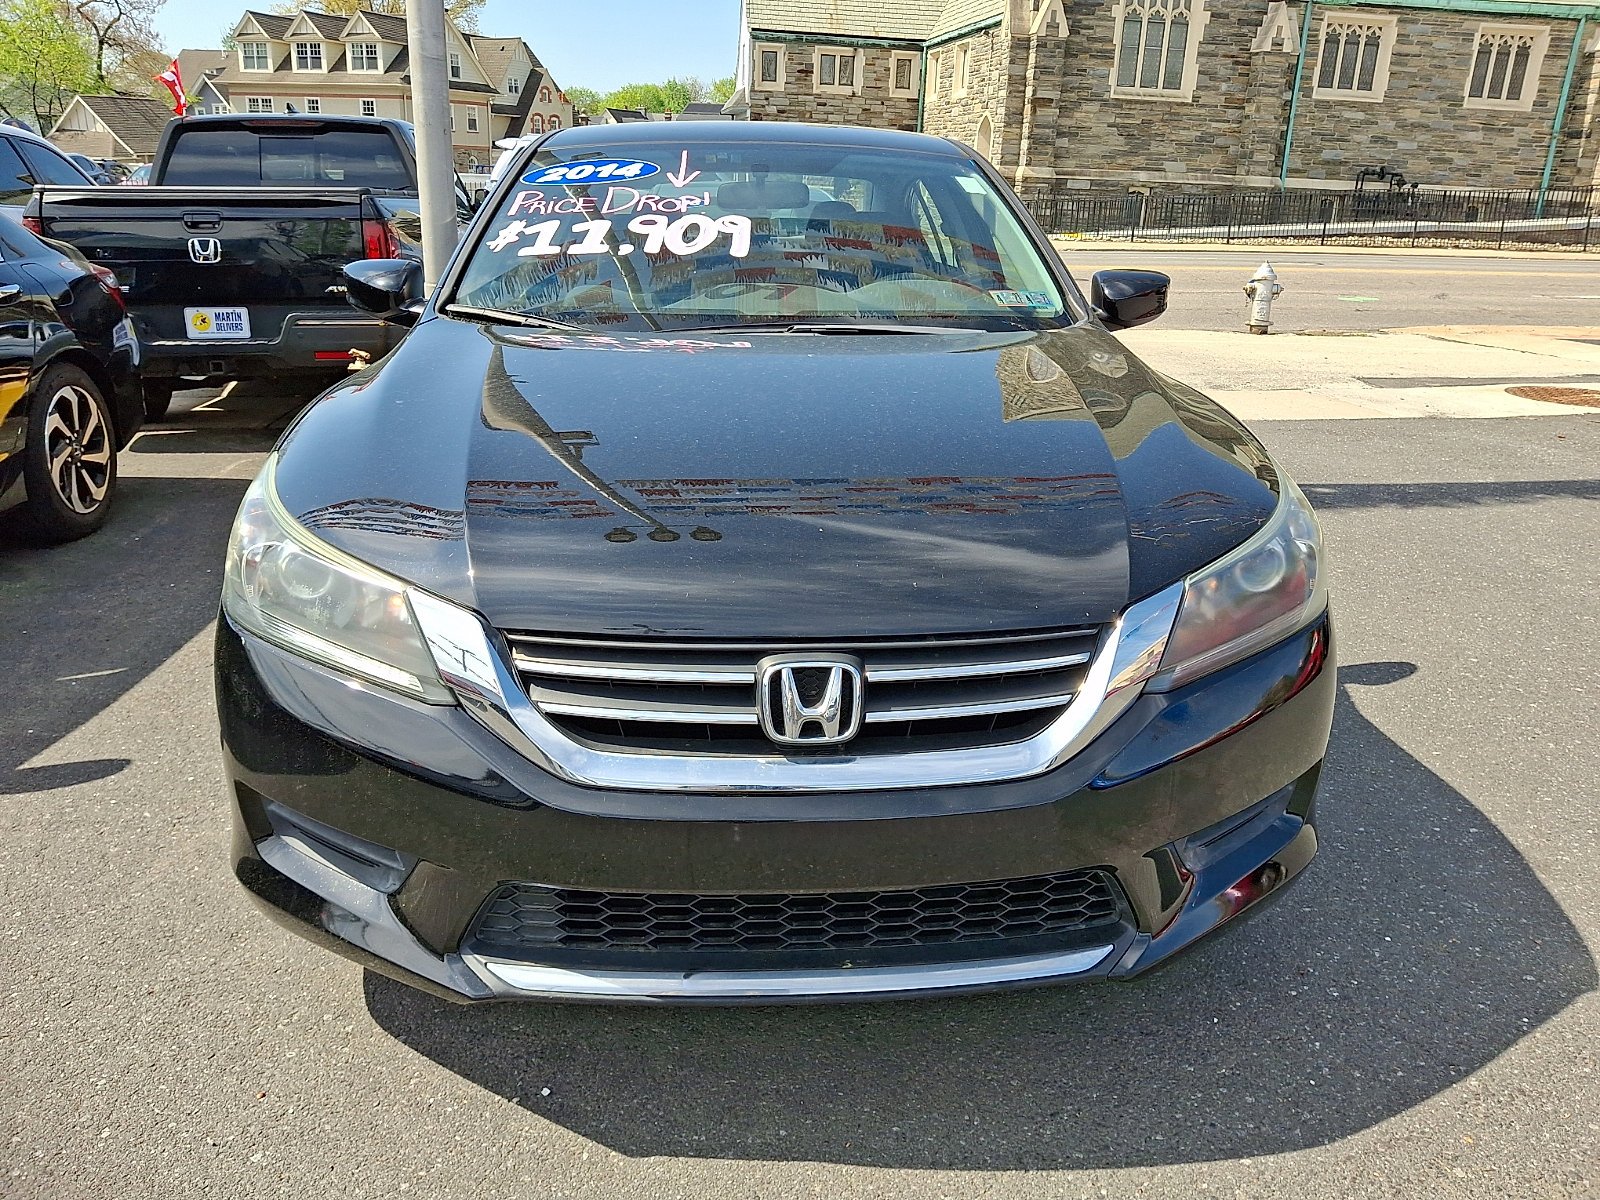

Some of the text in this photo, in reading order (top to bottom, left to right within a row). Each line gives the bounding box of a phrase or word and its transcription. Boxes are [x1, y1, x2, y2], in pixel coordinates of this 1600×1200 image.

[535, 162, 644, 183] 2014
[324, 285, 348, 293] AW
[214, 311, 242, 322] MARTIN
[215, 322, 243, 332] DELIVERS
